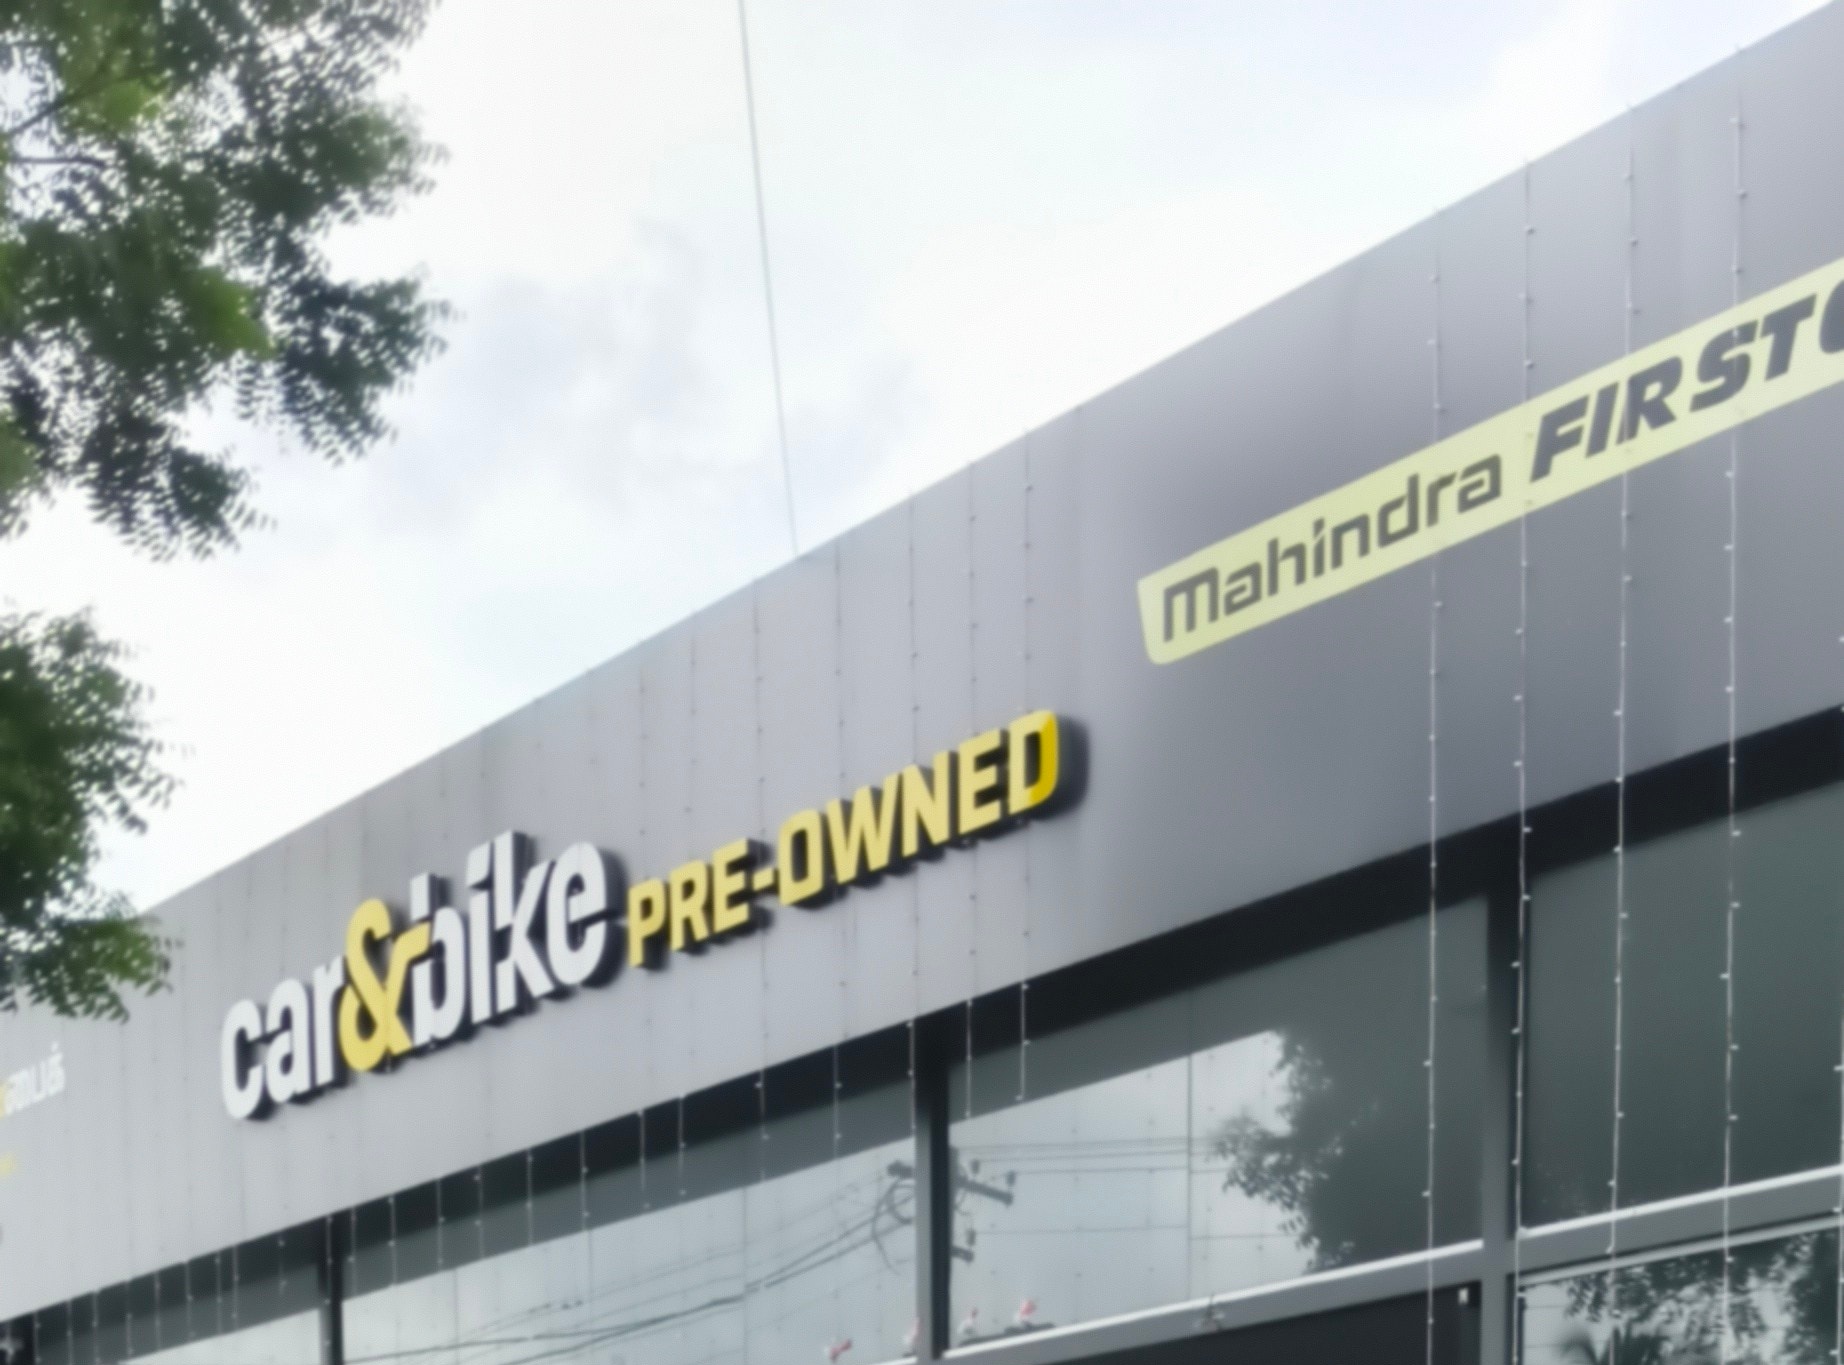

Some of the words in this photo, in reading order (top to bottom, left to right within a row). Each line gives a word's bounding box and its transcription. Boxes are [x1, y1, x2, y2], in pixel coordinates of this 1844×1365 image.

[1162, 452, 1503, 643] Mahindra
[1528, 291, 1818, 484] FIRST
[220, 829, 608, 1120] car&bike
[627, 708, 1060, 968] PRE-OWNED
